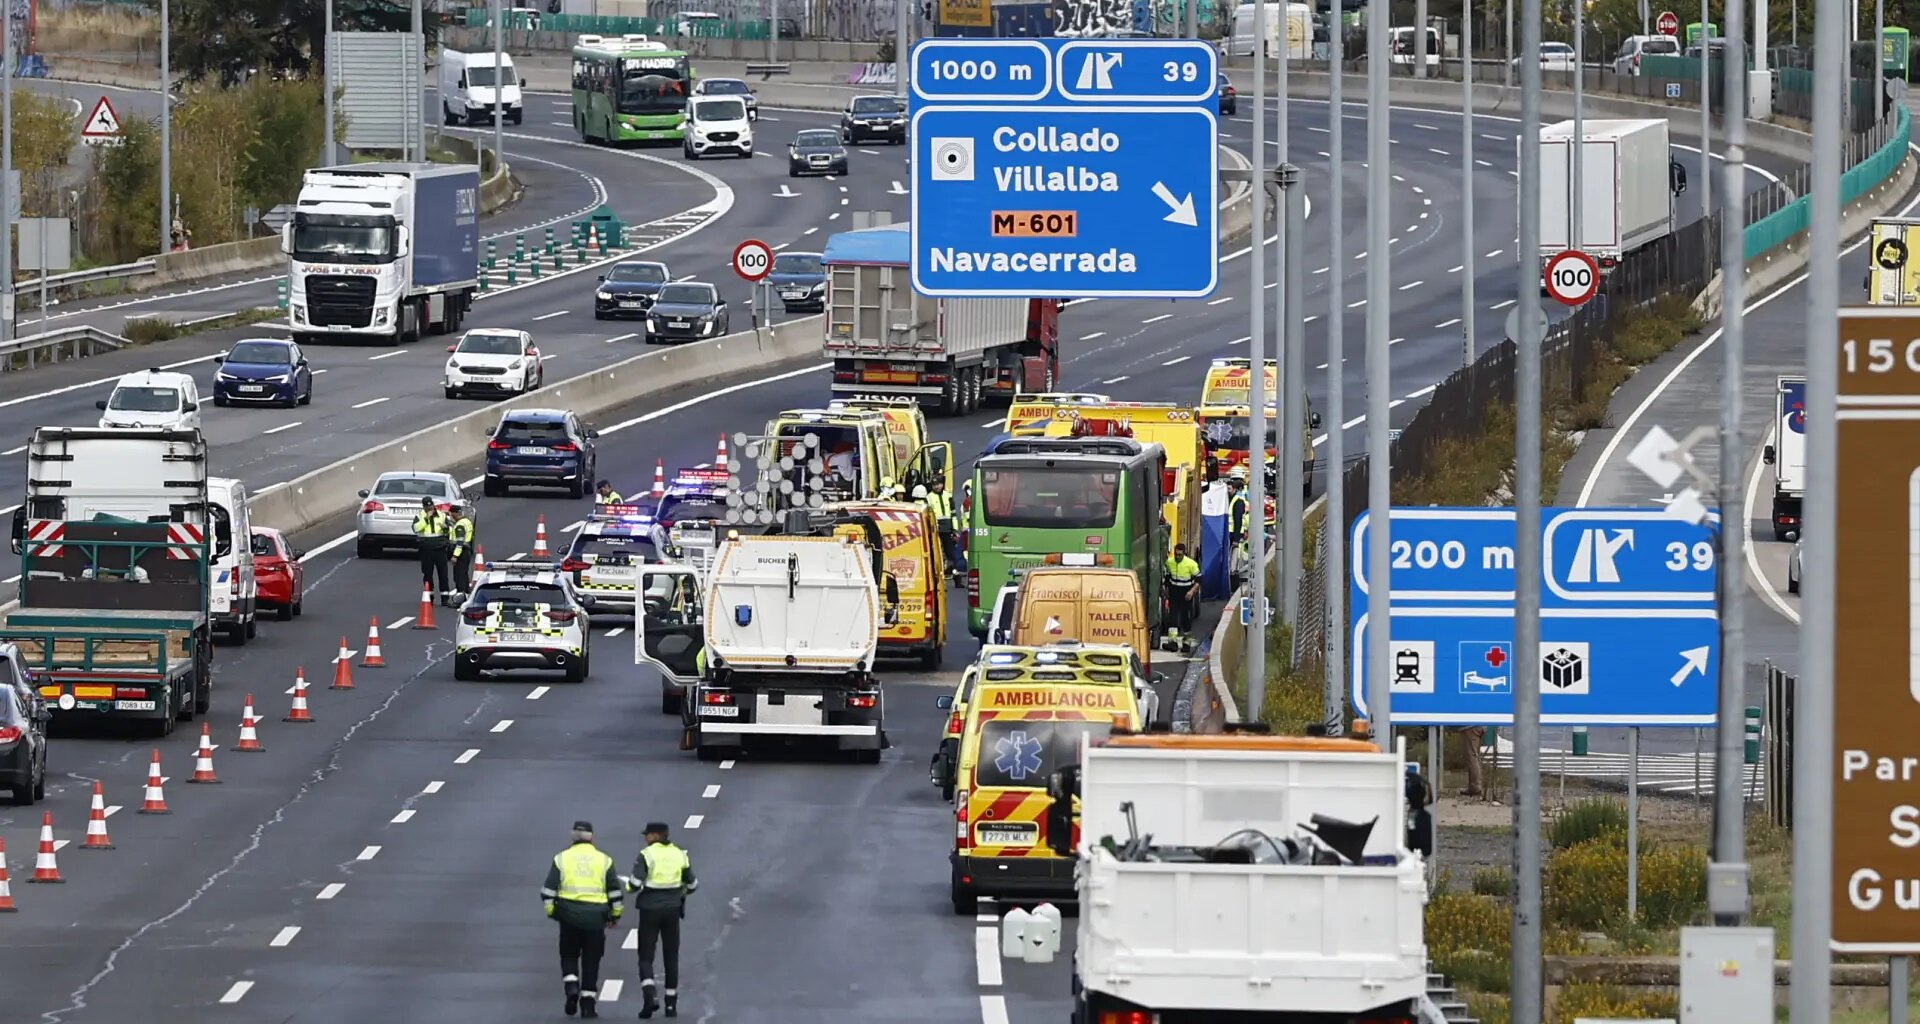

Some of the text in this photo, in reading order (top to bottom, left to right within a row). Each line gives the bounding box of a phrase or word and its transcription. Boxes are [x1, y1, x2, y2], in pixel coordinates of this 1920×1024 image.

[1660, 21, 1676, 29] STOP
[641, 58, 675, 69] MADRID
[930, 60, 1032, 80] 1000 m
[1163, 61, 1198, 82] 39
[993, 126, 1120, 153] Collado
[993, 166, 1119, 192] Villalba
[994, 214, 1074, 234] M-601
[740, 254, 766, 267] 100
[930, 248, 1137, 273] Navacerrada
[1554, 269, 1591, 286] 100
[975, 528, 989, 536] 155
[1391, 540, 1514, 569] 200 m
[1665, 541, 1714, 571] 39
[1031, 587, 1080, 600] Francisco
[1089, 613, 1131, 621] TALLER
[1092, 628, 1127, 637] MOVIL
[994, 691, 1116, 708] AMBULANCIA
[1843, 749, 1918, 781] Par
[1848, 867, 1920, 911] Gu
